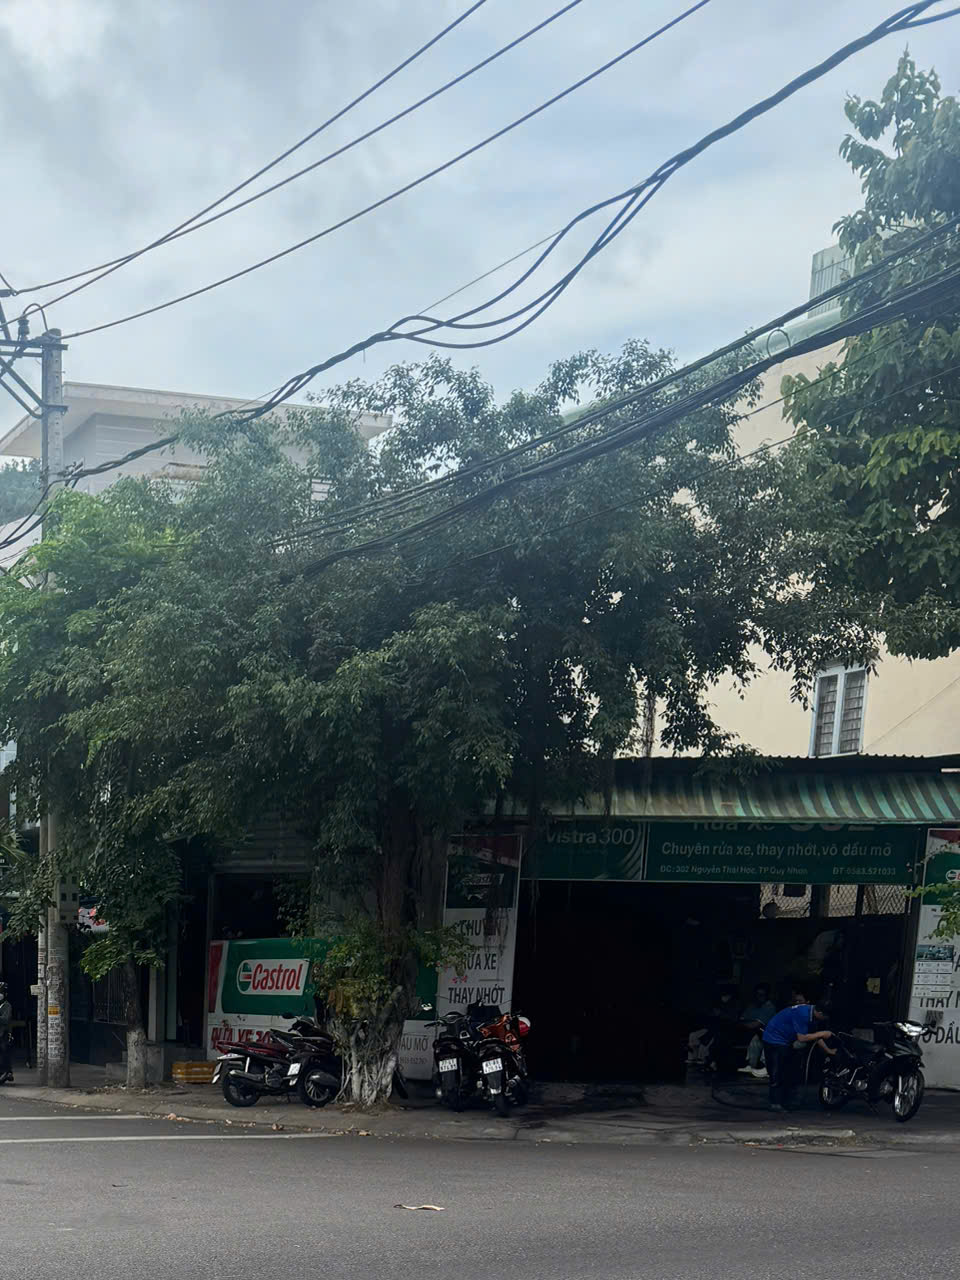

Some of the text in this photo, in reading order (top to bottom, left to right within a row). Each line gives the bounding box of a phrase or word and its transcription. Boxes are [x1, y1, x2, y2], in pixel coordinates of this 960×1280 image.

[600, 827, 635, 845] 300
[661, 841, 709, 858] Chuyên
[712, 841, 733, 856] rửa
[736, 844, 754, 857] xe,
[756, 842, 785, 859] thay
[460, 919, 502, 936] CHUYN
[484, 953, 497, 970] XE
[252, 963, 302, 990] Castrol
[448, 984, 505, 1004] THAY NHỚT
